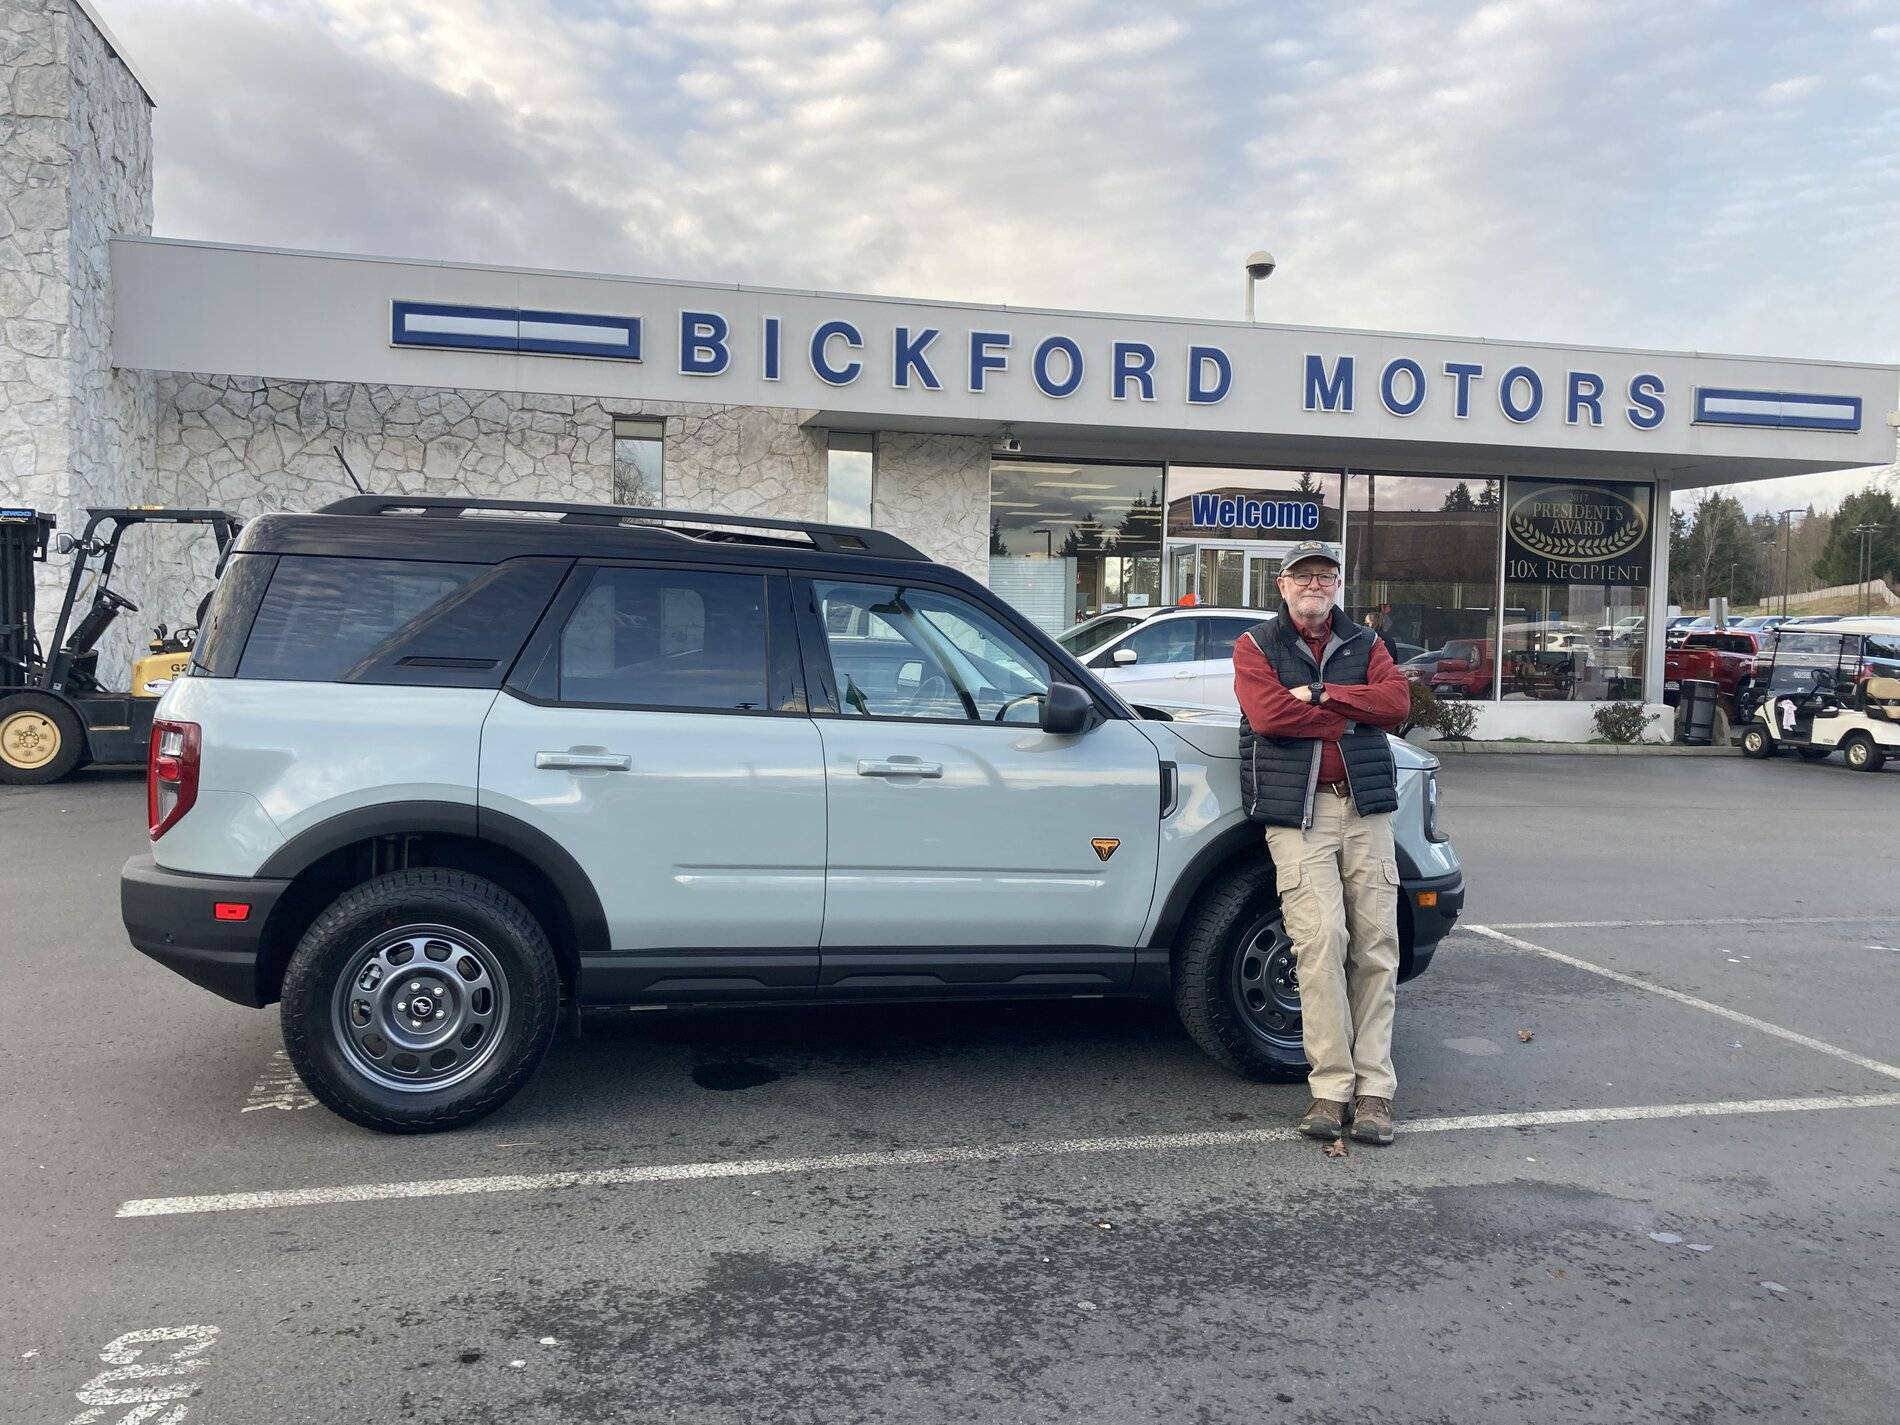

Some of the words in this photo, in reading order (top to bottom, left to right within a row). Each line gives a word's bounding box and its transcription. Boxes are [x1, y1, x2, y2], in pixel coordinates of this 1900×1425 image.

[678, 310, 1234, 404] BICKFORD
[1302, 352, 1666, 431] MOTORS
[1191, 493, 1319, 530] Welcome
[1532, 502, 1625, 521] PRESIDENT'S
[1550, 519, 1605, 536] AWARD
